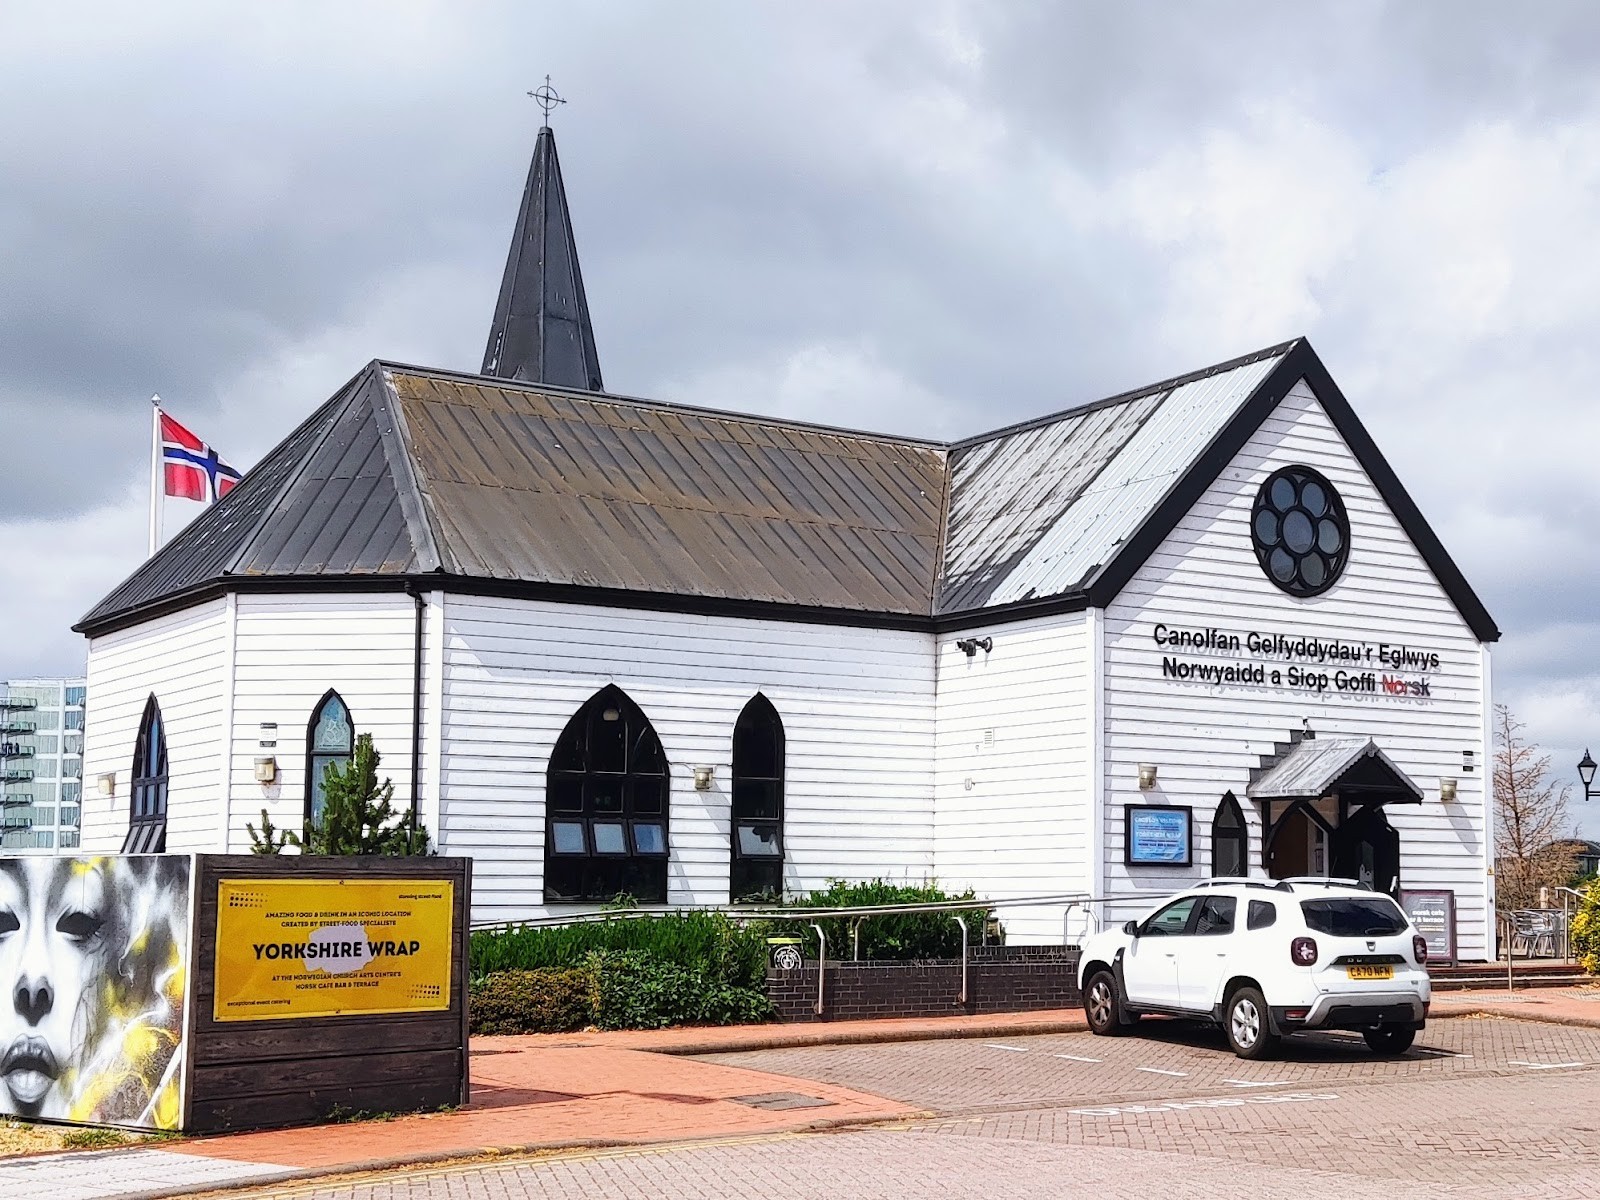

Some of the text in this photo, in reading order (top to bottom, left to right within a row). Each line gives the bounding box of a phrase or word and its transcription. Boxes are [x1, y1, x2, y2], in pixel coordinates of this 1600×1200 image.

[1153, 623, 1440, 671] Canolfan Gelfyddydau'r Eglwys
[1162, 656, 1431, 697] Norwyaidd a Siop Goffi Norsk
[252, 940, 420, 960] YORKSHIRE WRAP
[293, 973, 332, 981] NORWEGIAN
[332, 972, 358, 980] CHURCH
